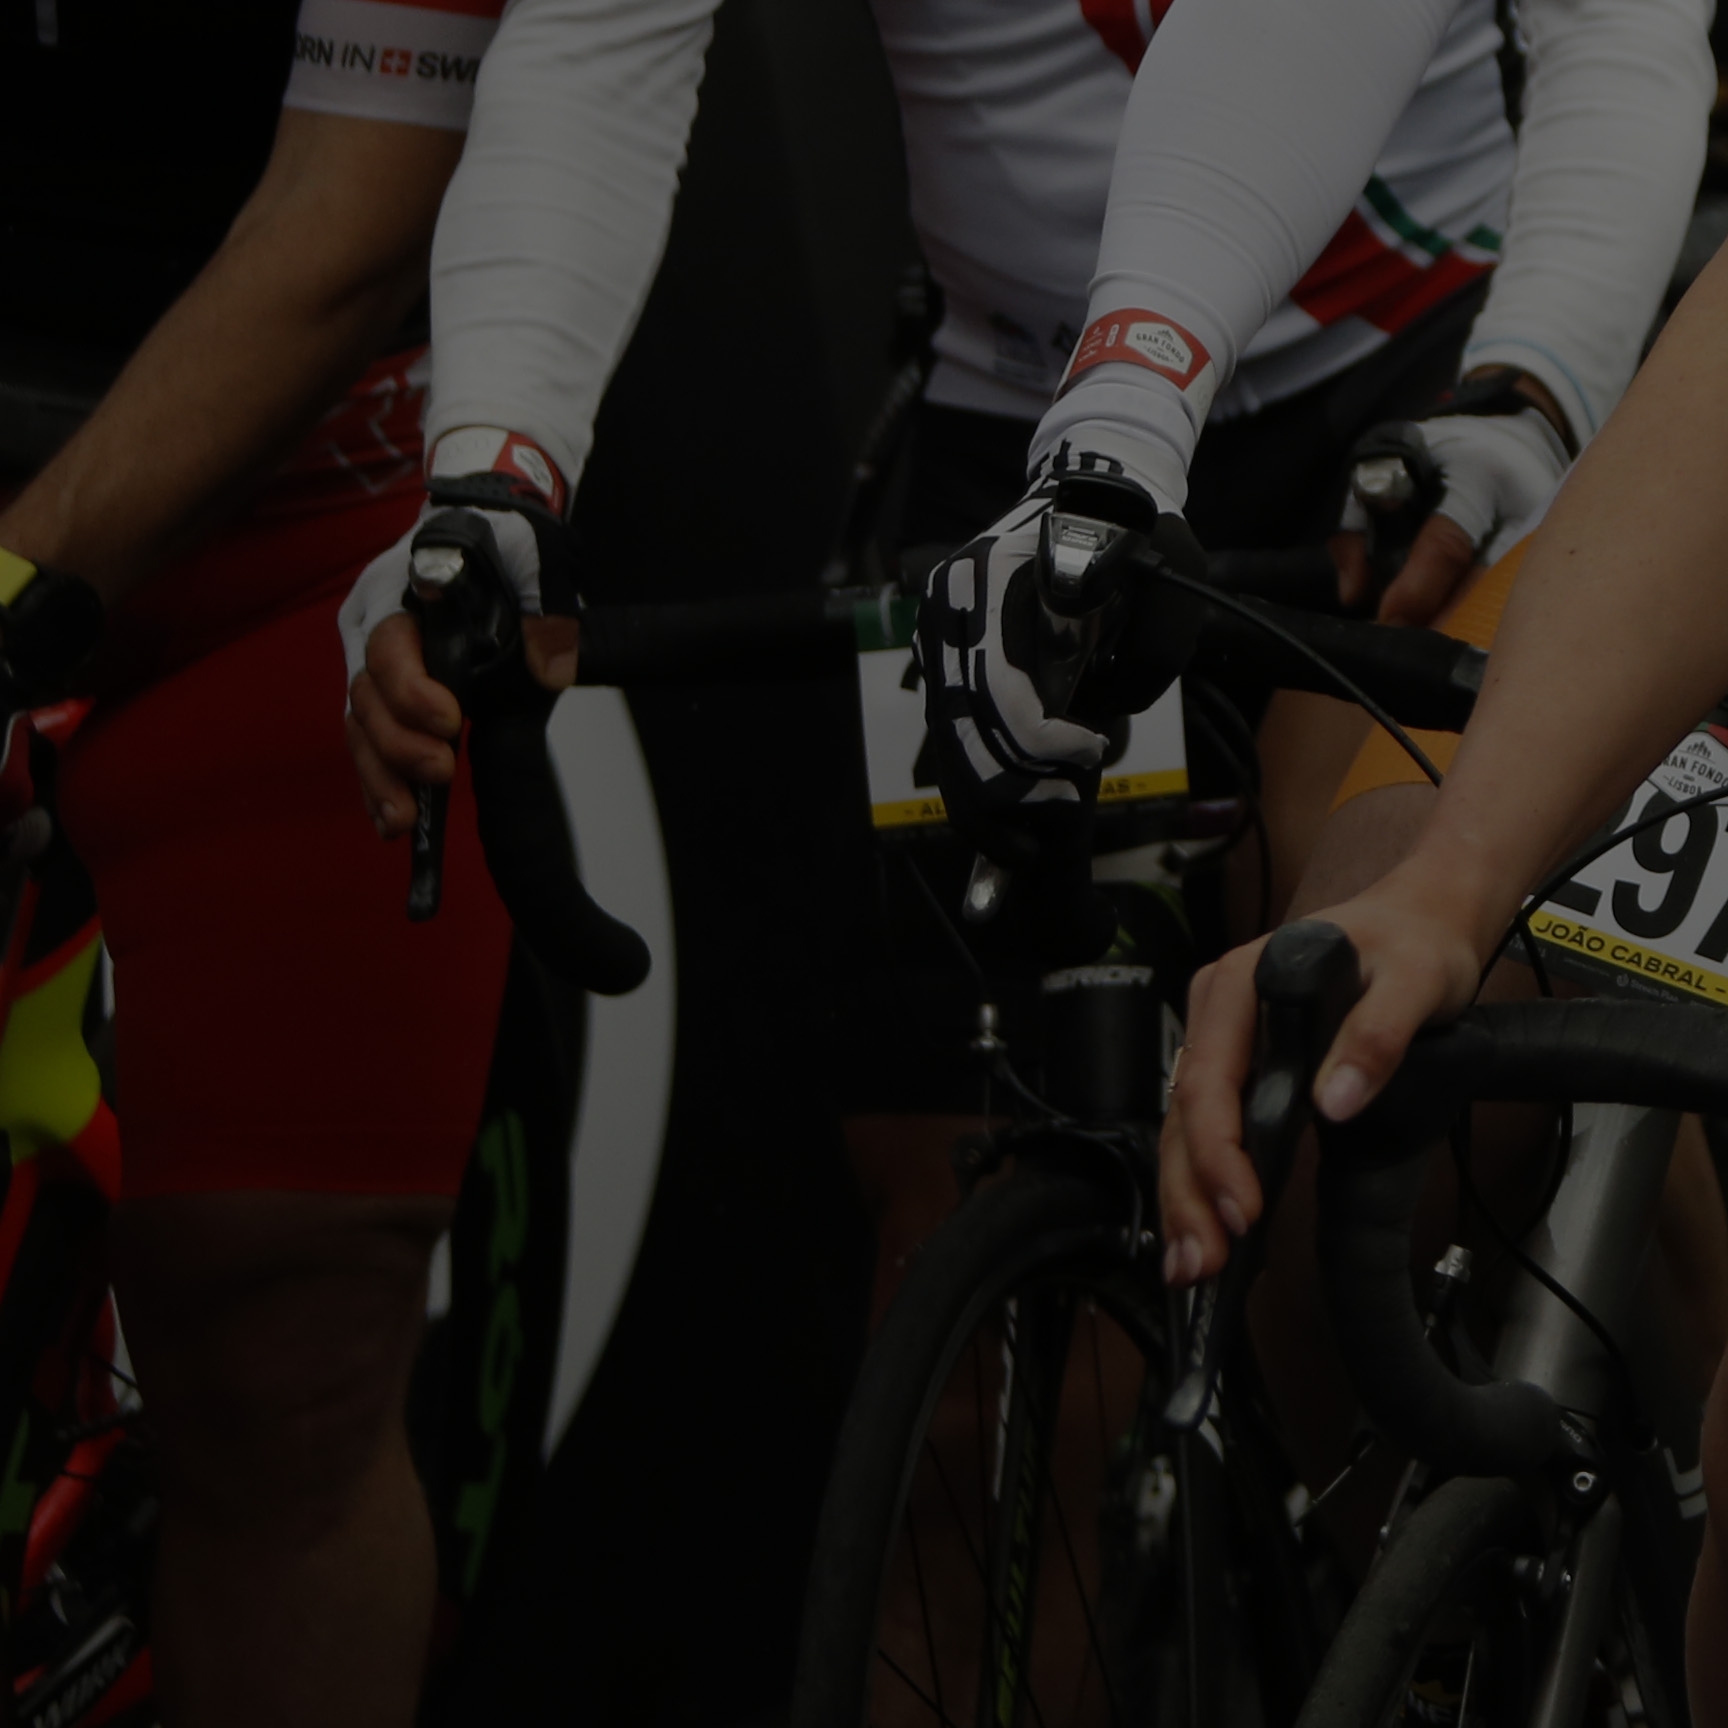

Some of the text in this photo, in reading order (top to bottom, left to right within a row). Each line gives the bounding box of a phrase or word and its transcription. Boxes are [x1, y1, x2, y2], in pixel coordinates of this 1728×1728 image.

[342, 41, 375, 73] IN
[1536, 920, 1605, 953] JOÃO
[1610, 944, 1707, 992] CABRAL
